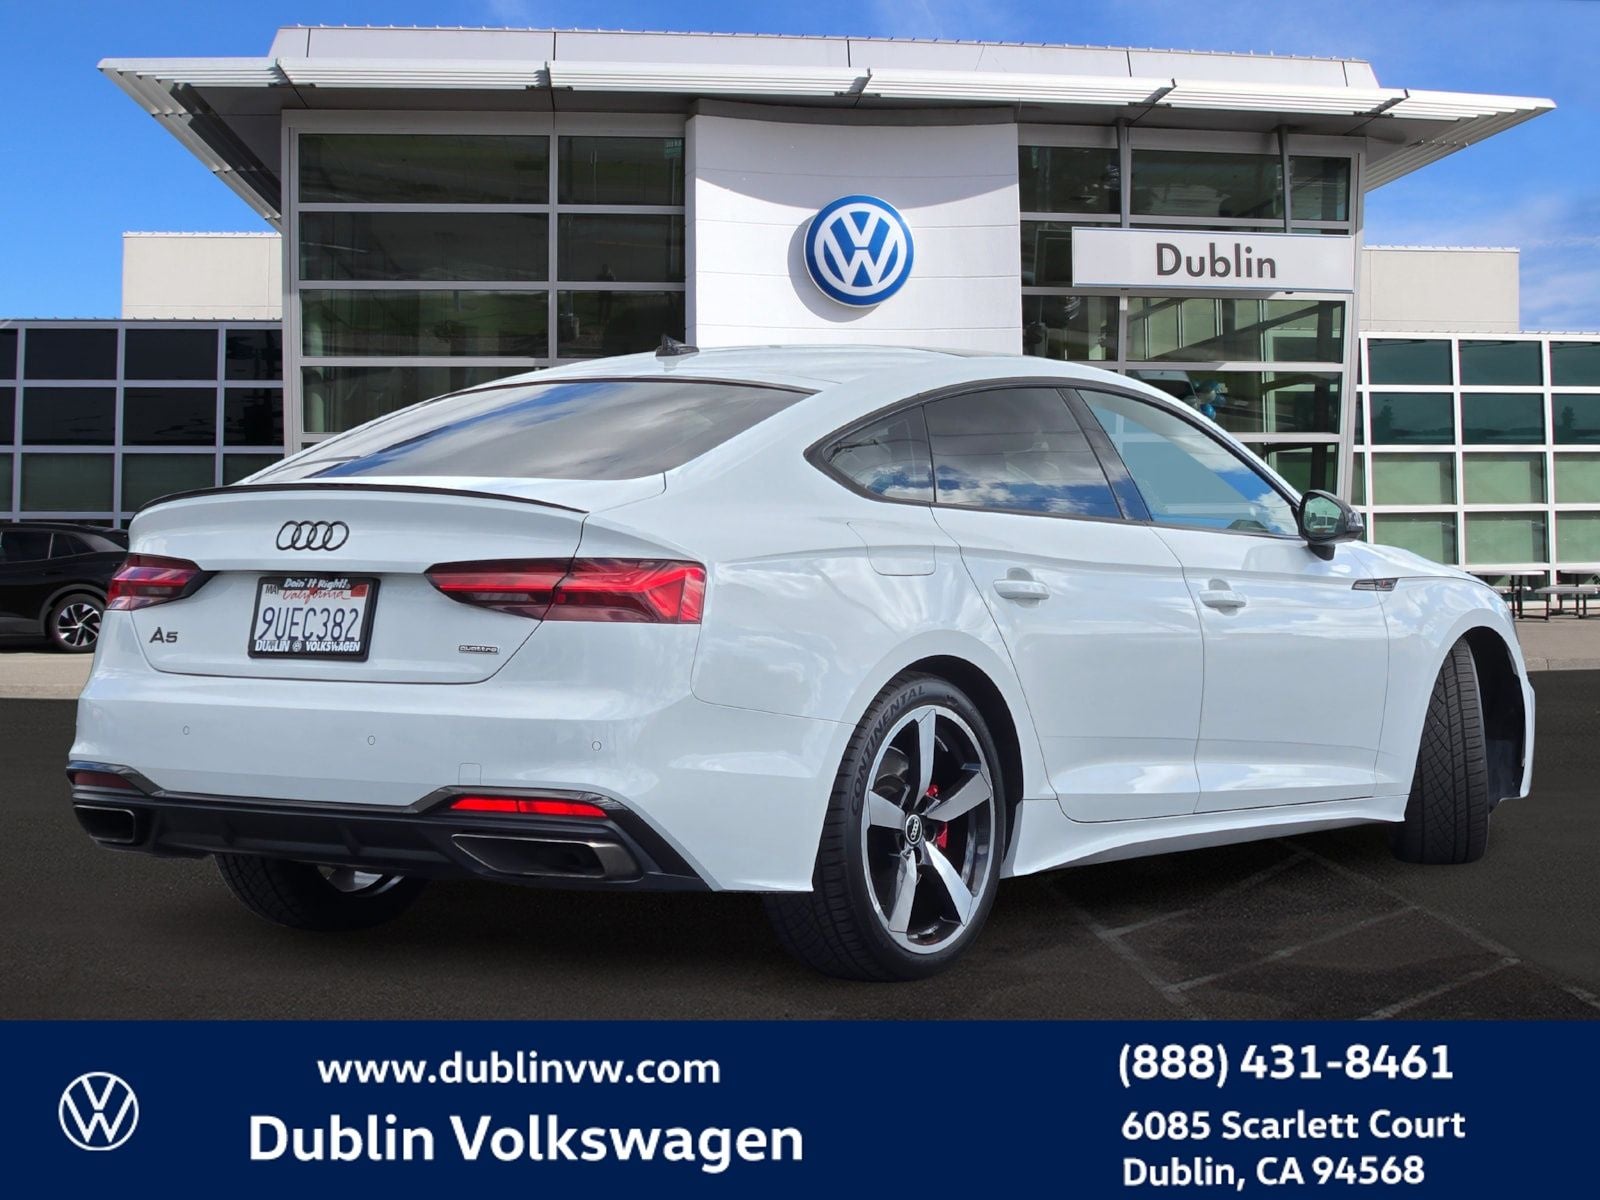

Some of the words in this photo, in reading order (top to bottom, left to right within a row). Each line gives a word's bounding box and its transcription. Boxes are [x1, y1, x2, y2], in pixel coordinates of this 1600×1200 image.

[1157, 242, 1276, 279] Dublin
[149, 627, 178, 643] A5
[258, 607, 359, 641] 9UEC382
[254, 640, 290, 652] DUBLIN
[306, 641, 361, 652] VOLKSWAGEN
[851, 685, 926, 816] CONTINENTAL
